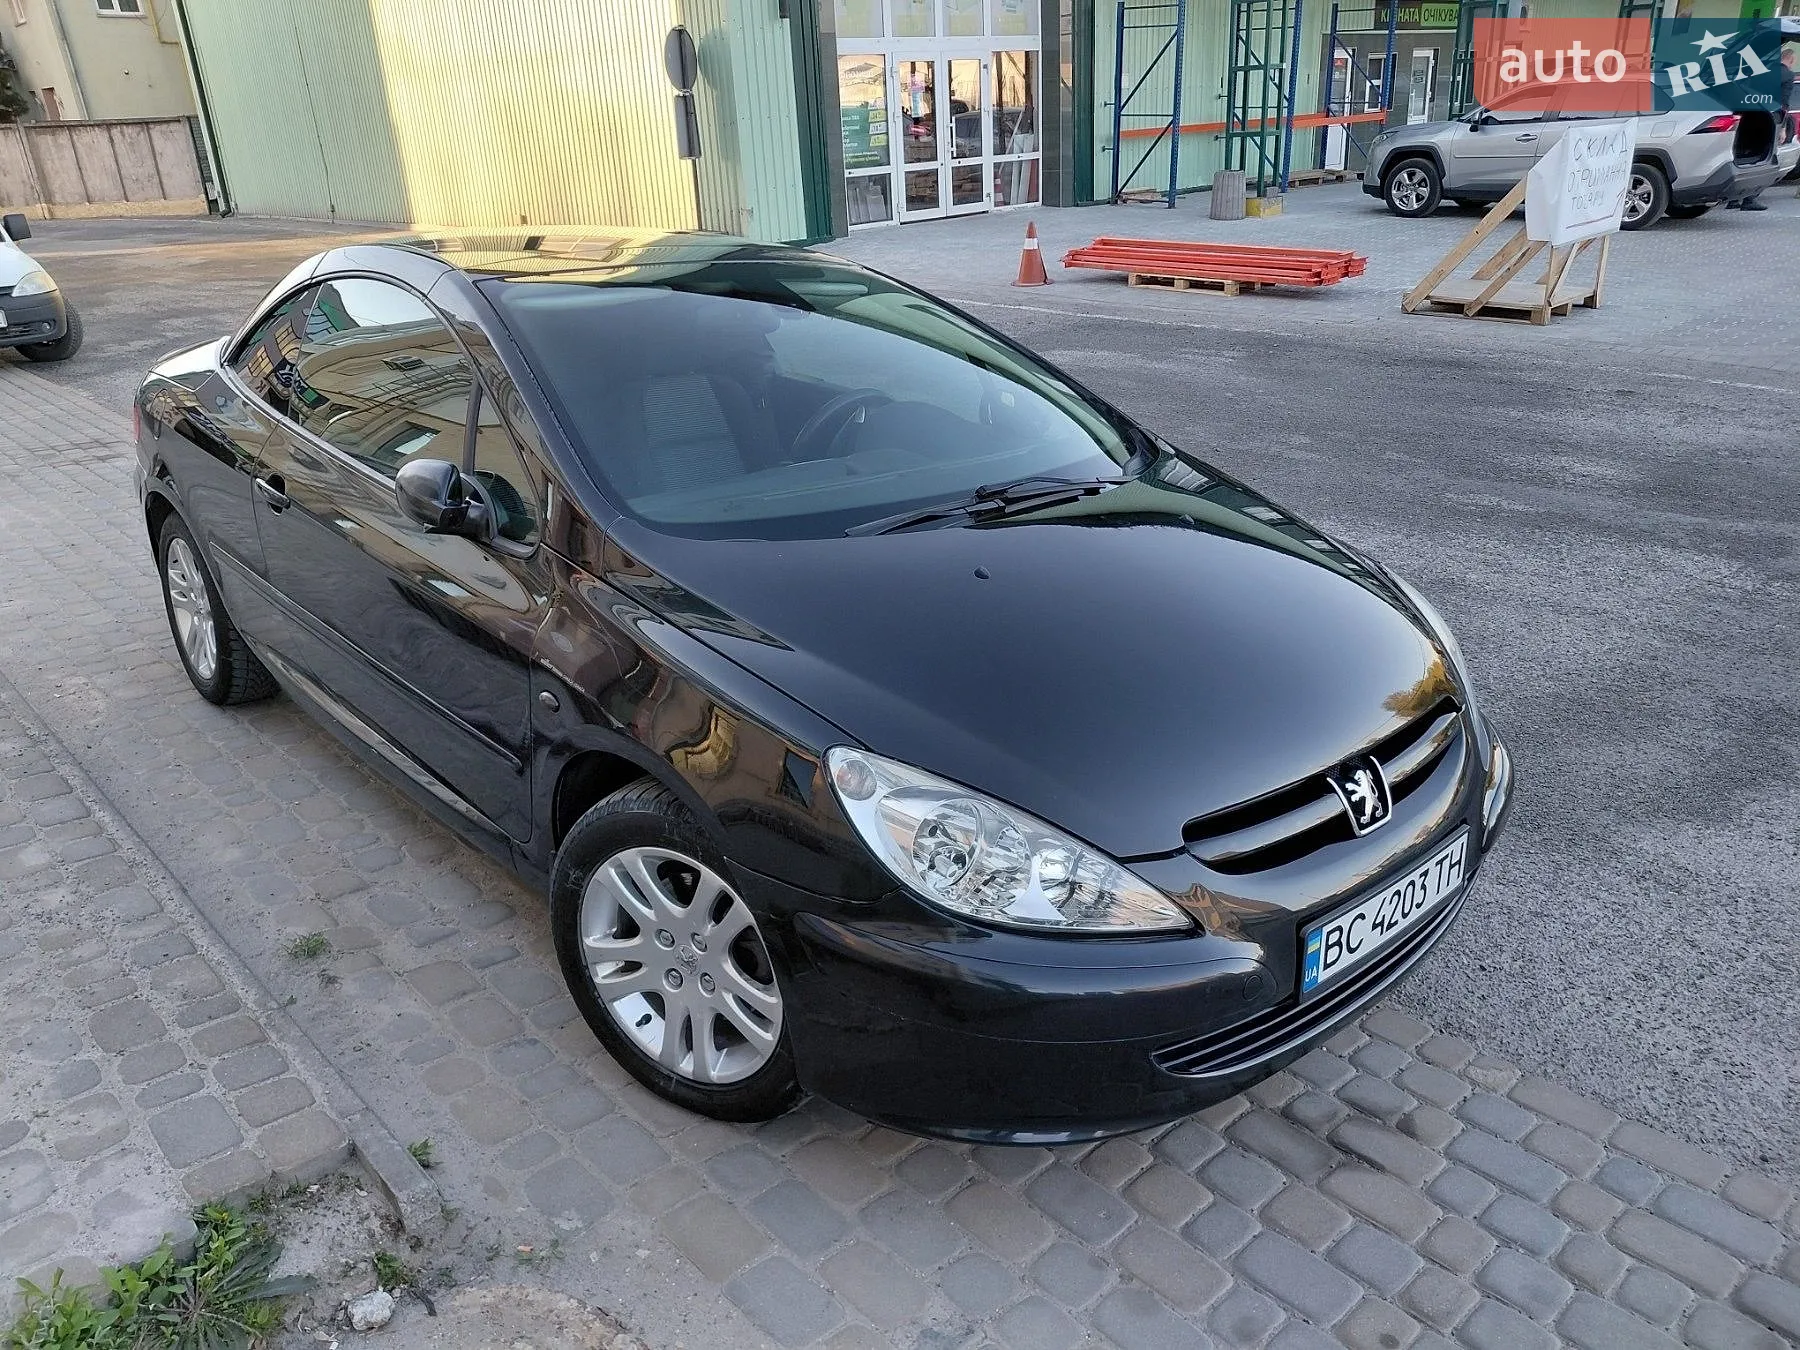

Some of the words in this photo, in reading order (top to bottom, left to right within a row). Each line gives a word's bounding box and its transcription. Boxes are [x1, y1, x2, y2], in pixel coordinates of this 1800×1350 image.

[1380, 7, 1420, 22] КІНАТА
[1322, 912, 1366, 971] BC
[1371, 868, 1429, 936] 4203
[1435, 842, 1464, 895] TH
[1304, 966, 1318, 983] UA
